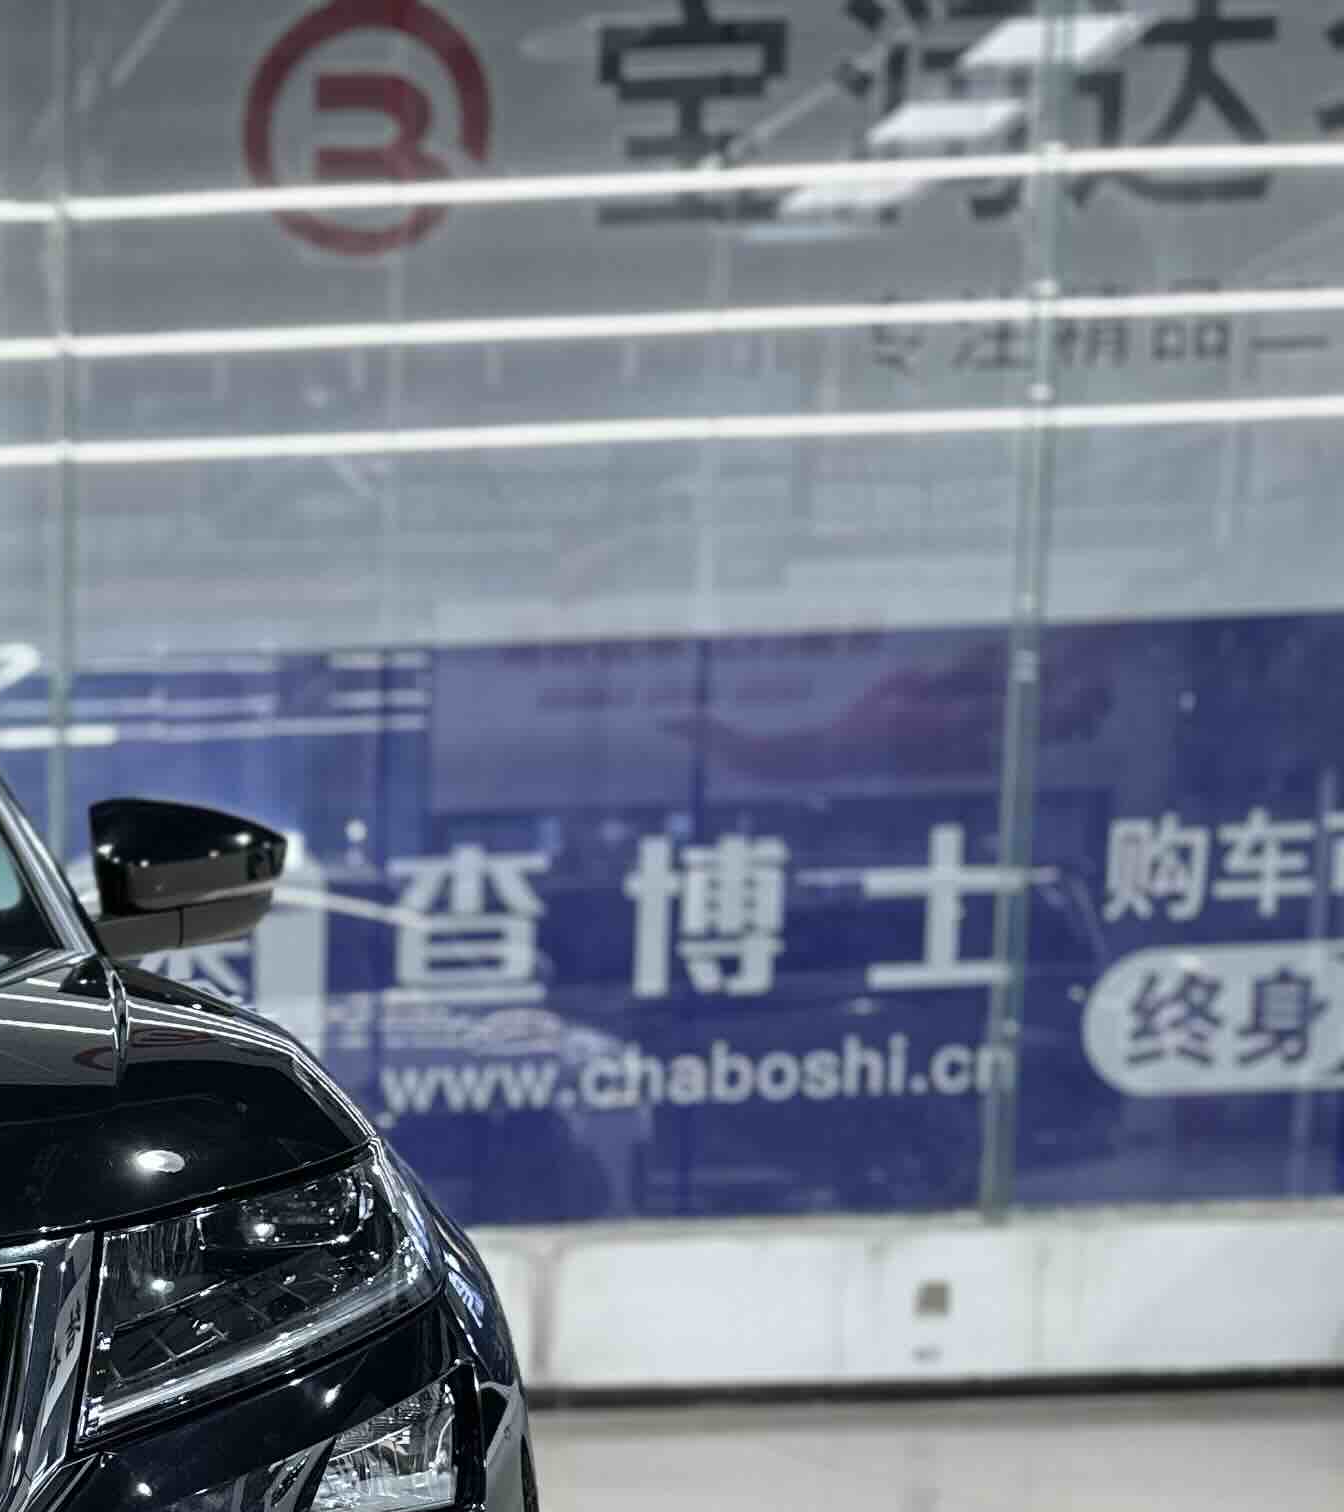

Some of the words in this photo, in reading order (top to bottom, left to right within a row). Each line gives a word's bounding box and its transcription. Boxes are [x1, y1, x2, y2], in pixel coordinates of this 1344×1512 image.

[388, 824, 1028, 1002] 查博士
[380, 1036, 1018, 1114] www.chaboshi.cn
